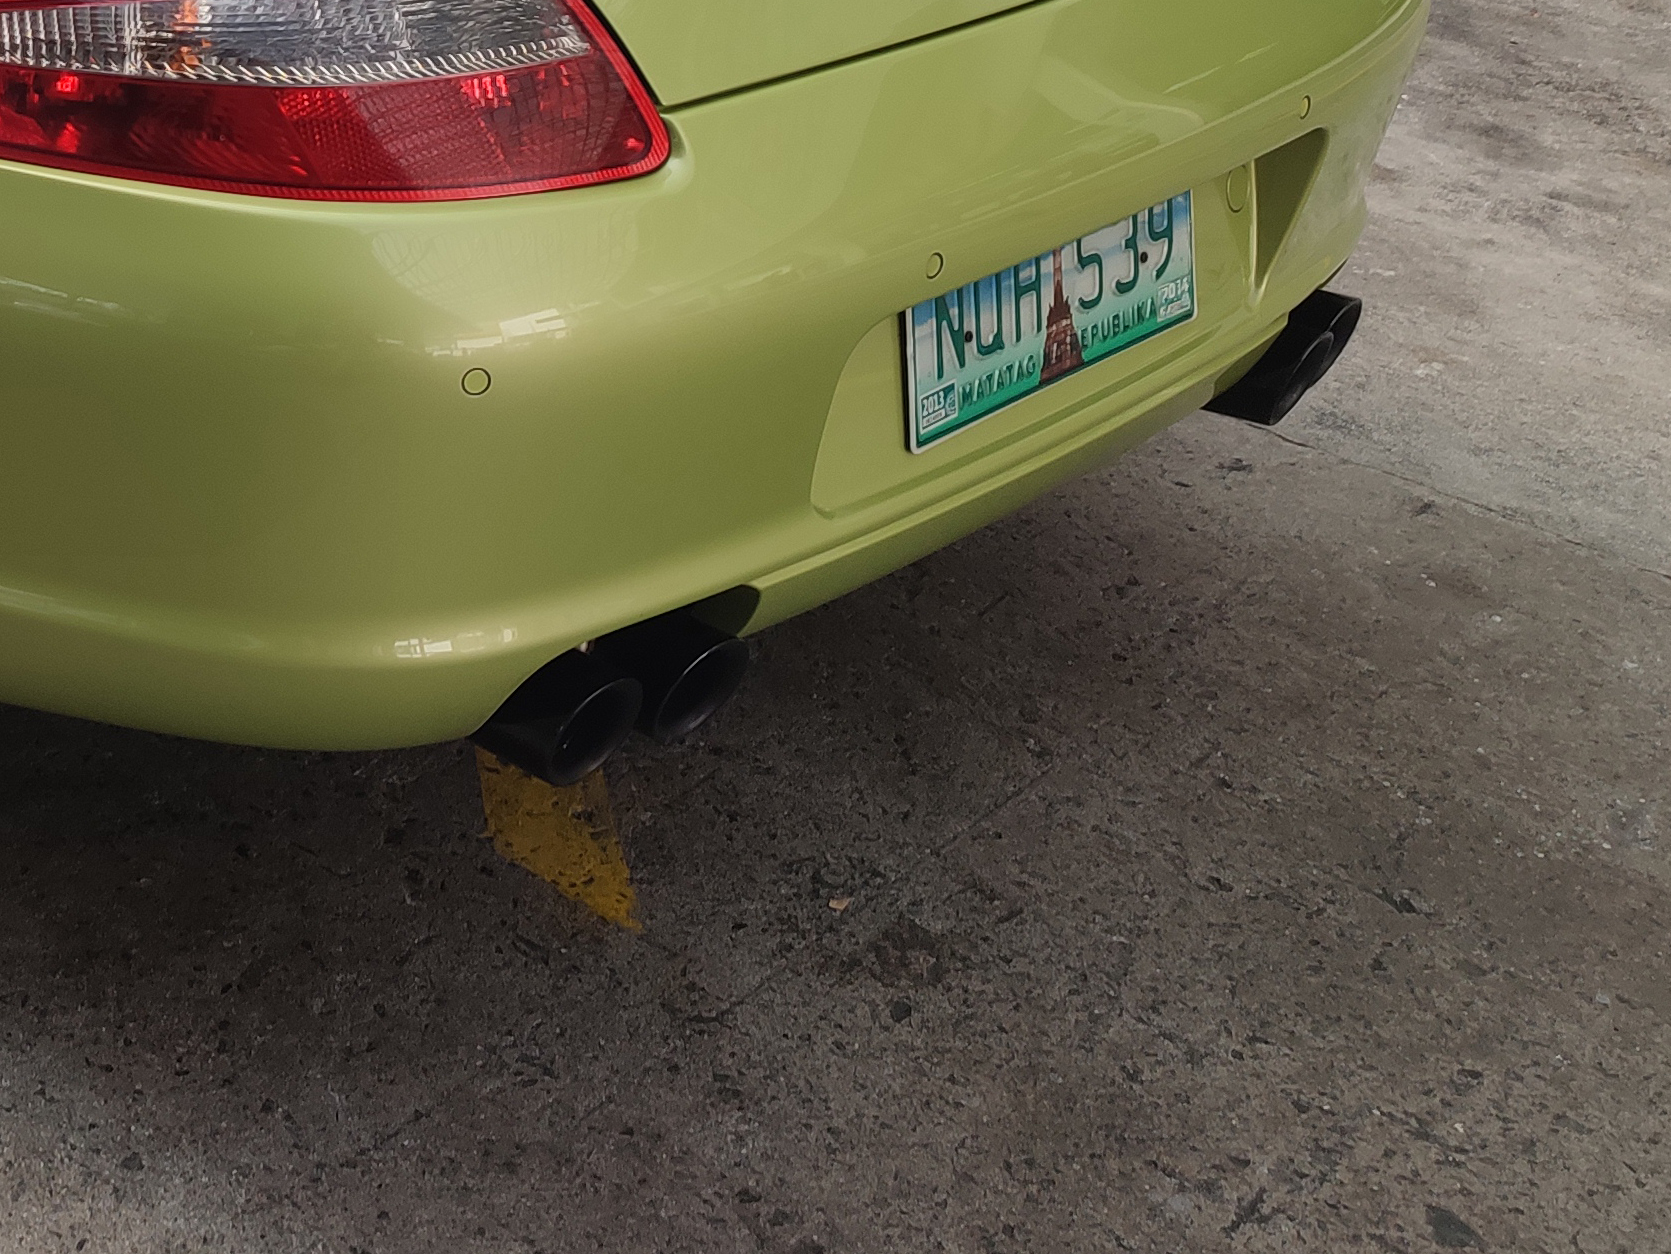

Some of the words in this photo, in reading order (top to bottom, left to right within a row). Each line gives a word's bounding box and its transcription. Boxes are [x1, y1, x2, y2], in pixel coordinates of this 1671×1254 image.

[1077, 198, 1174, 310] 539
[922, 391, 945, 417] 2013
[958, 354, 1036, 410] MATATAG
